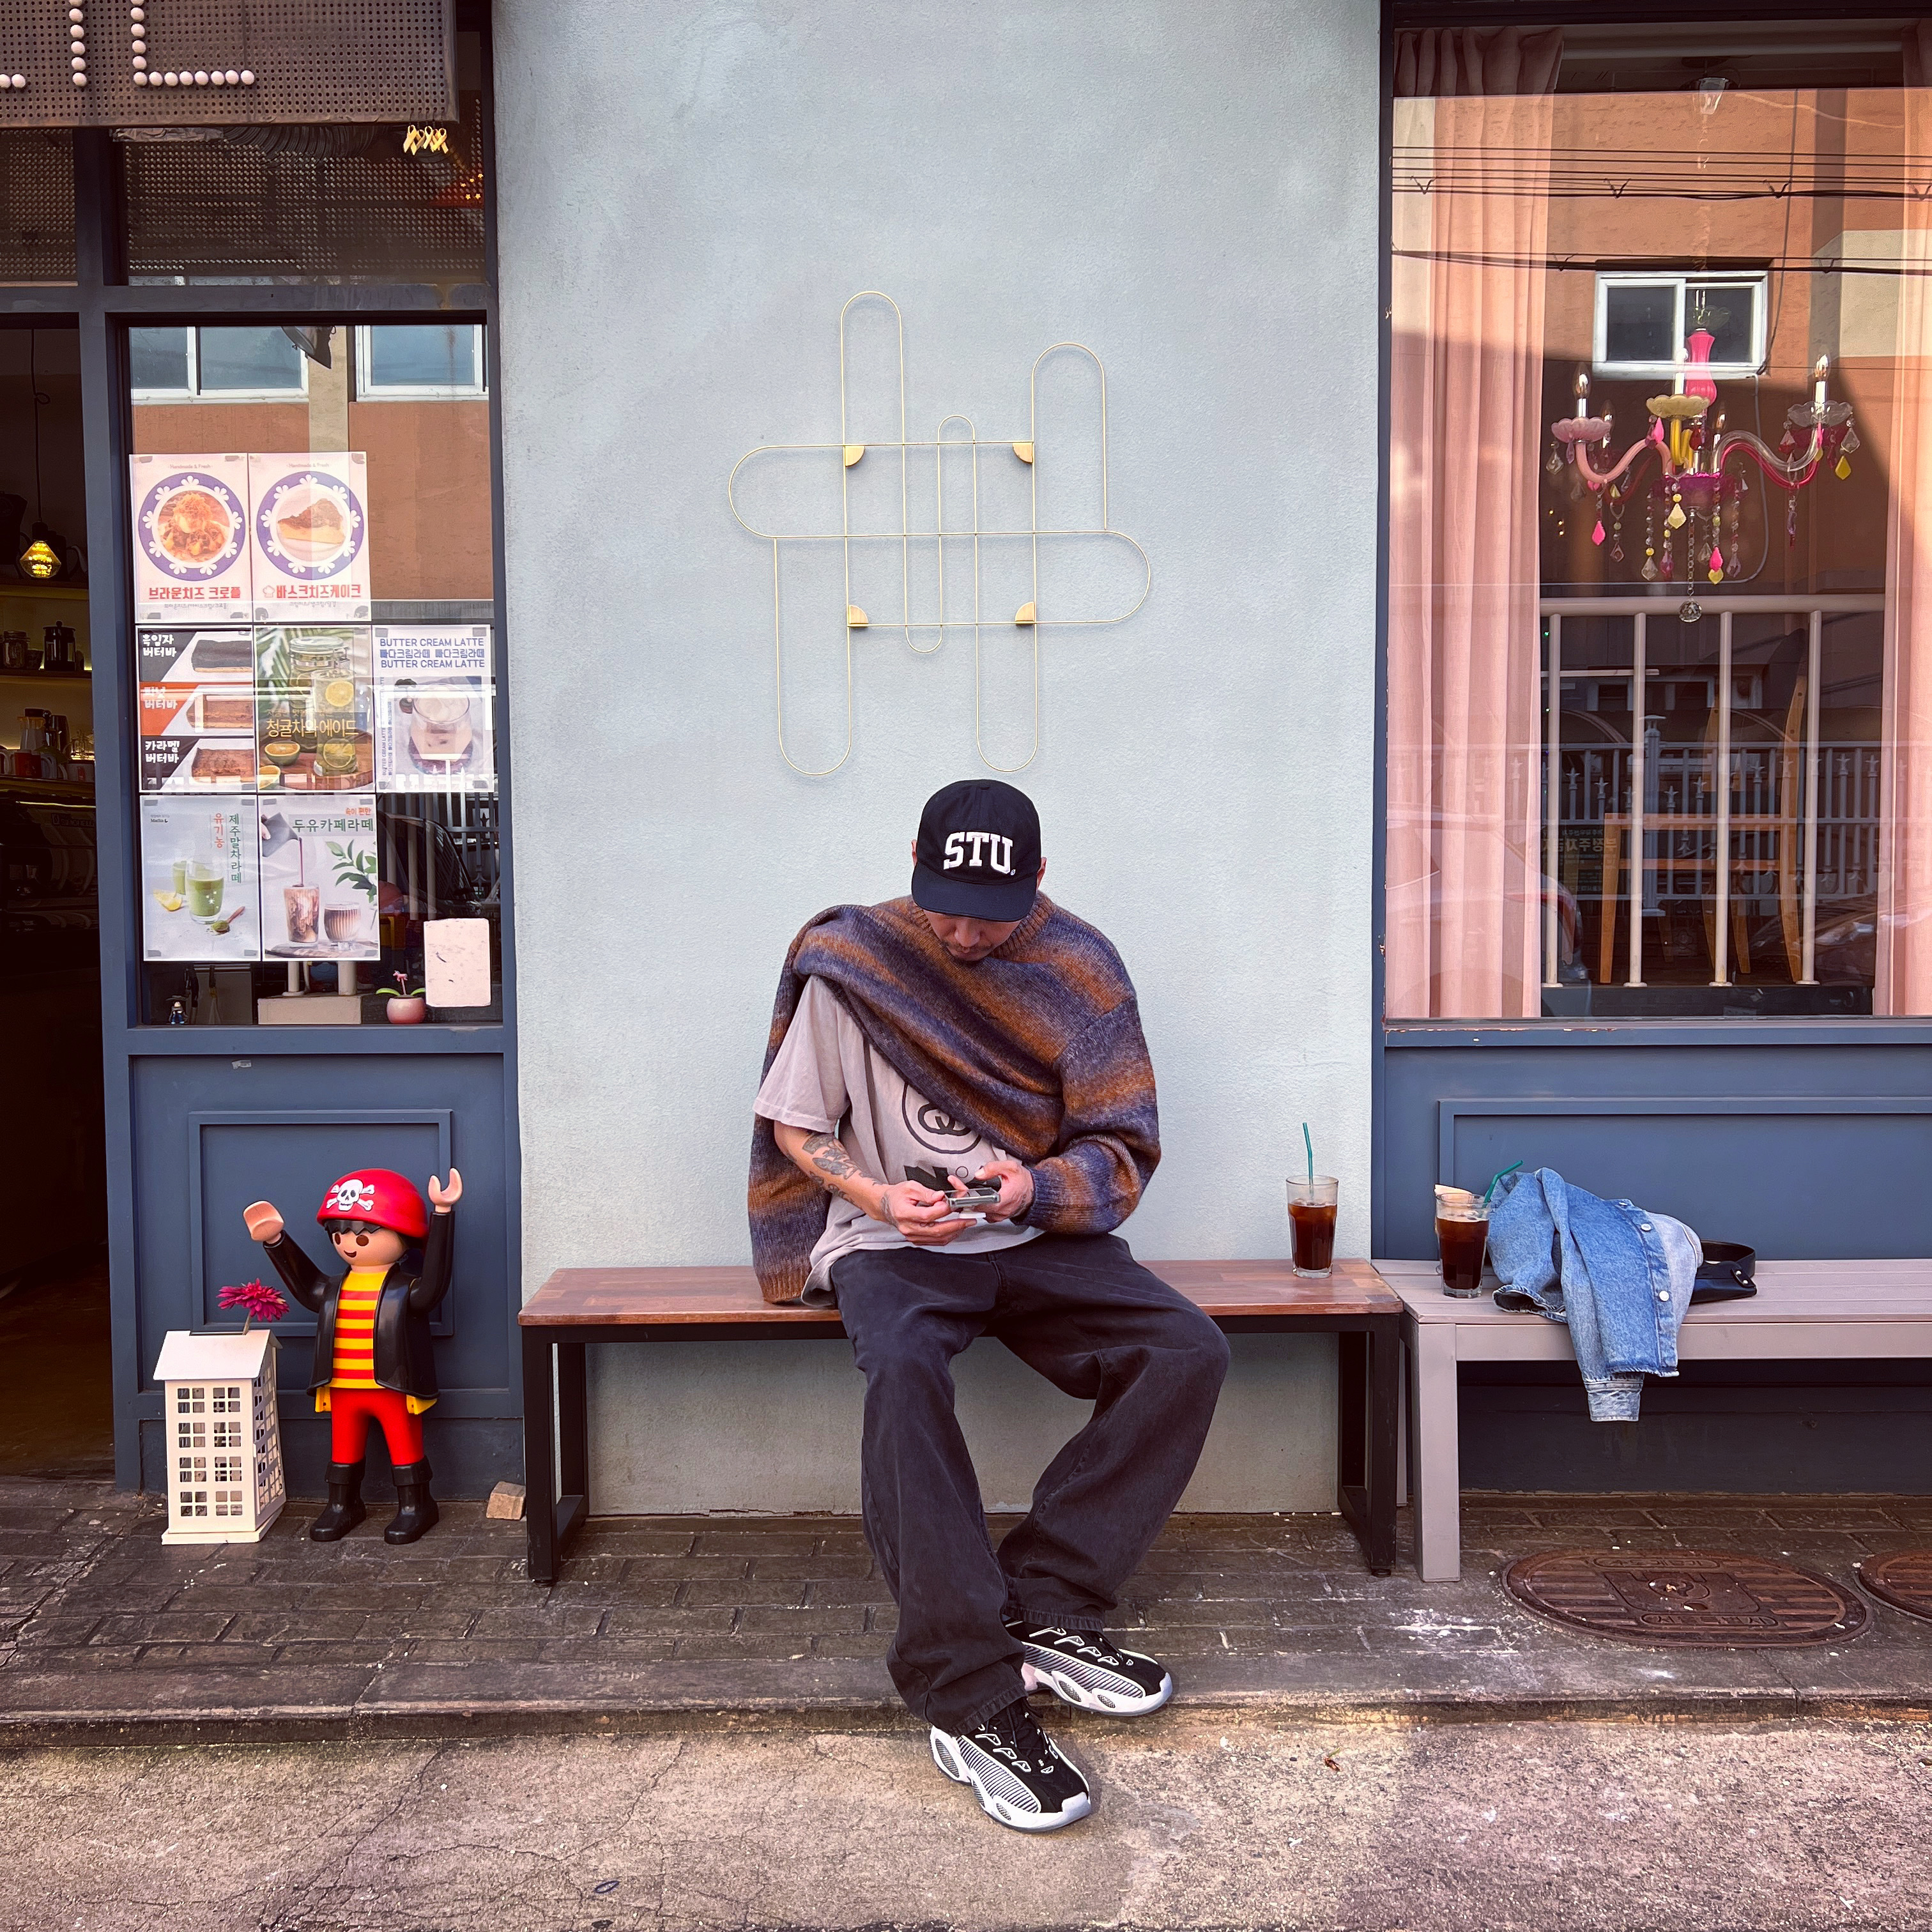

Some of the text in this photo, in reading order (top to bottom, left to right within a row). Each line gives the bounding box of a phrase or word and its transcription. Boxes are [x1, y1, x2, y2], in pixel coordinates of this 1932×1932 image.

[149, 586, 241, 599] 브라운치즈 크로플
[276, 585, 362, 599] 바스크치즈케이크
[142, 634, 174, 647] 흑임자
[380, 638, 484, 647] BUTTER CREAM LATTE
[142, 647, 177, 657] 버터바
[381, 659, 485, 668] BUTTER CREAM LATTE
[144, 700, 178, 710] 버터바
[266, 719, 359, 737] 청귤차와 에이드
[144, 740, 180, 753] 카라멜
[145, 753, 180, 763] 버터바
[213, 813, 225, 848] 유기농
[292, 818, 374, 832] 두유카페라떼
[229, 813, 242, 884] 제주말차라떼
